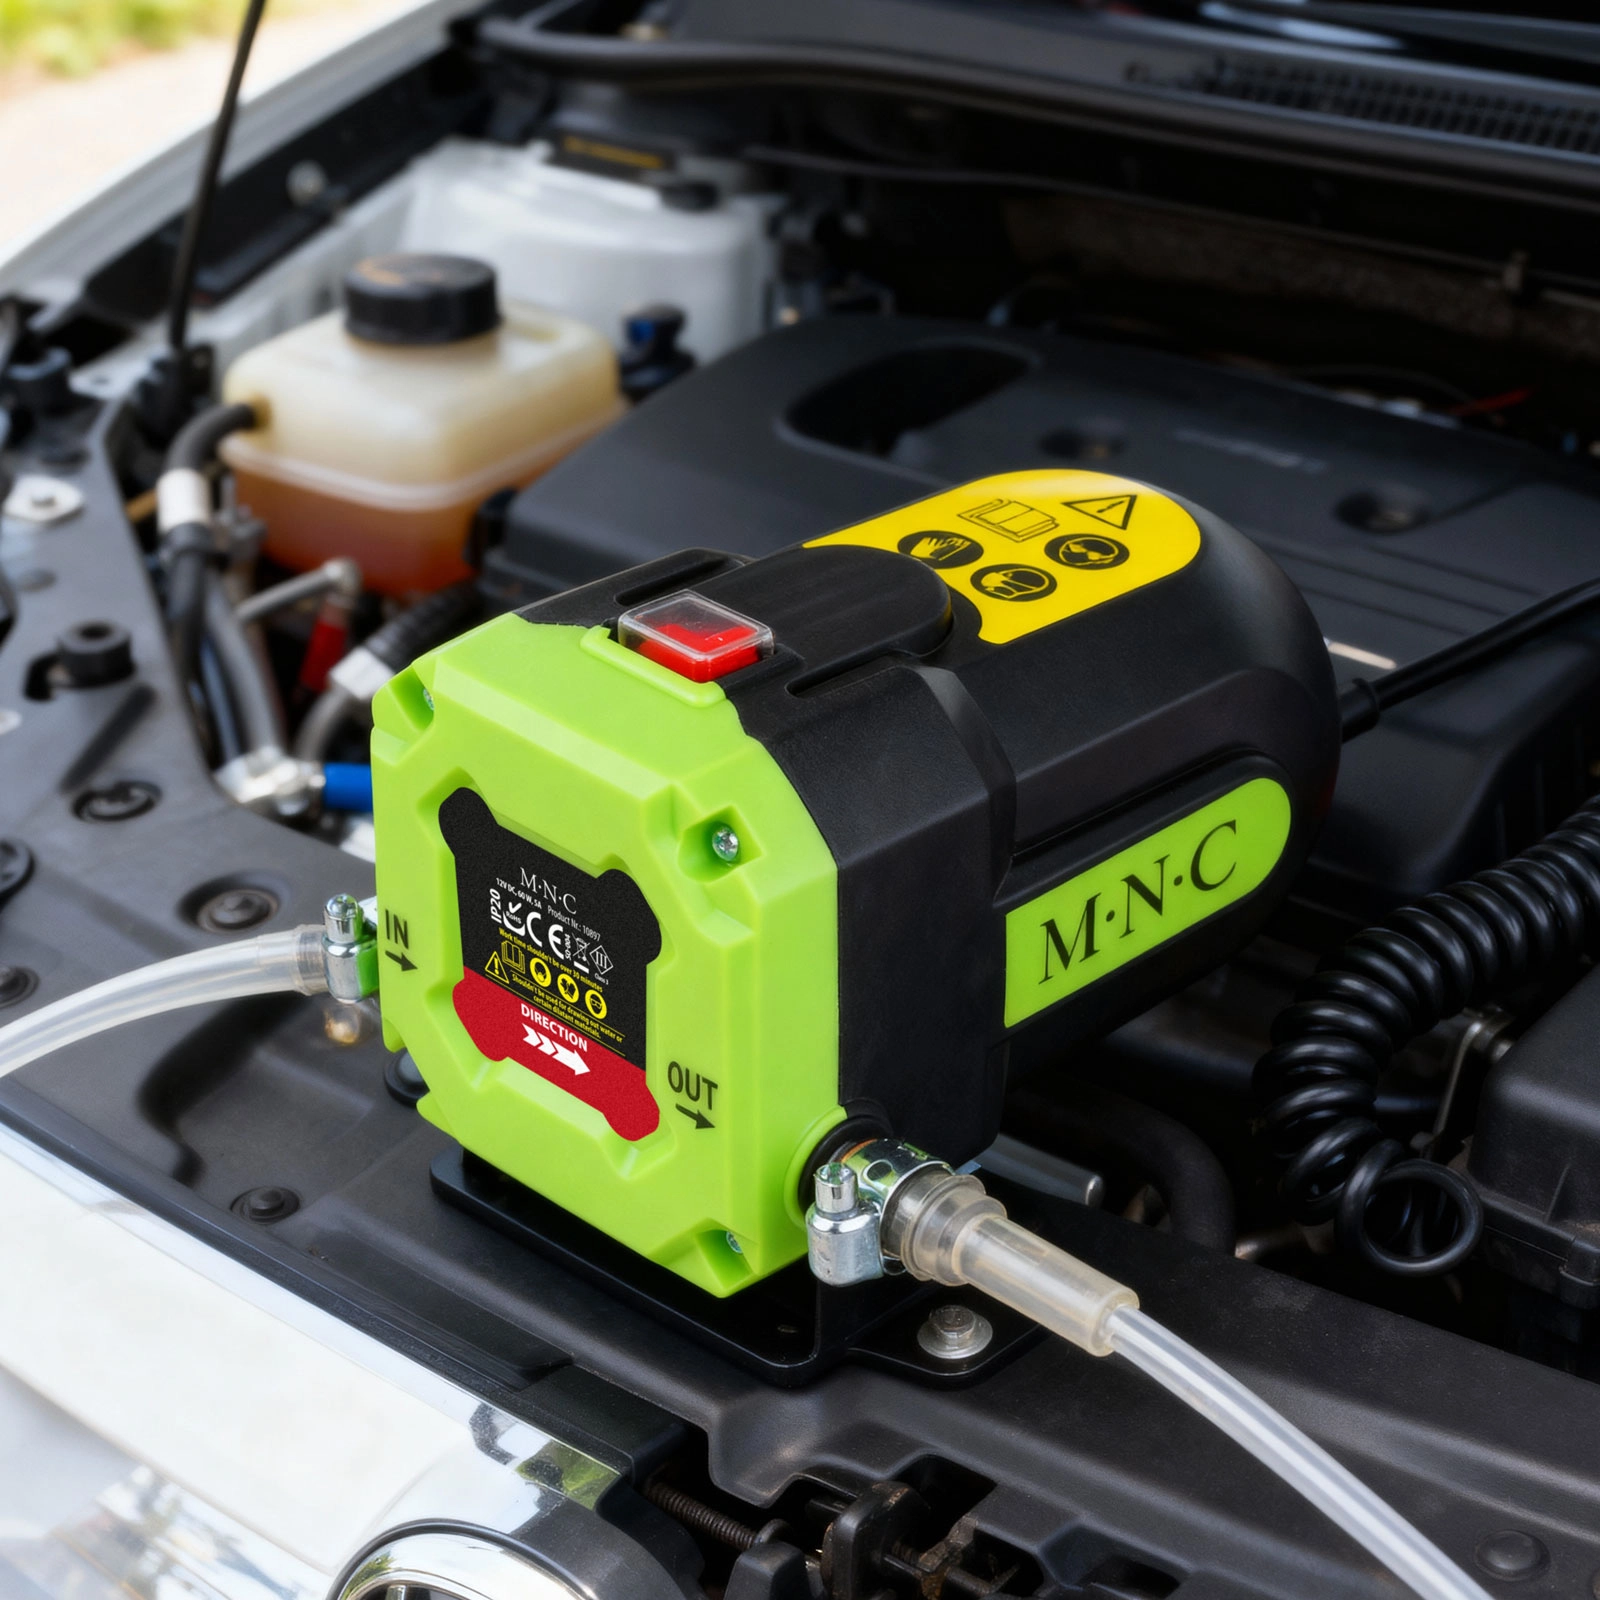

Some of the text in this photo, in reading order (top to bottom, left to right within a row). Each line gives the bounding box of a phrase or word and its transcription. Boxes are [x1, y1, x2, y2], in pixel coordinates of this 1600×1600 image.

[489, 888, 503, 924] IP20
[496, 877, 507, 890] 12V
[517, 890, 526, 900] 60
[534, 898, 542, 909] 5A
[385, 908, 409, 950] IN
[505, 911, 522, 924] RoHS
[526, 911, 565, 960] CE
[547, 904, 601, 942] Product Nr.: 10897
[498, 927, 603, 993] Work time shouldn't be over 30 minutes
[594, 972, 605, 984] Class
[512, 973, 623, 1044] Shouldn't be used for drawing out water or
[520, 1002, 588, 1052] DIRECTION
[533, 995, 553, 1011] certain
[574, 1019, 601, 1039] materials.
[667, 1060, 719, 1111] OUT
